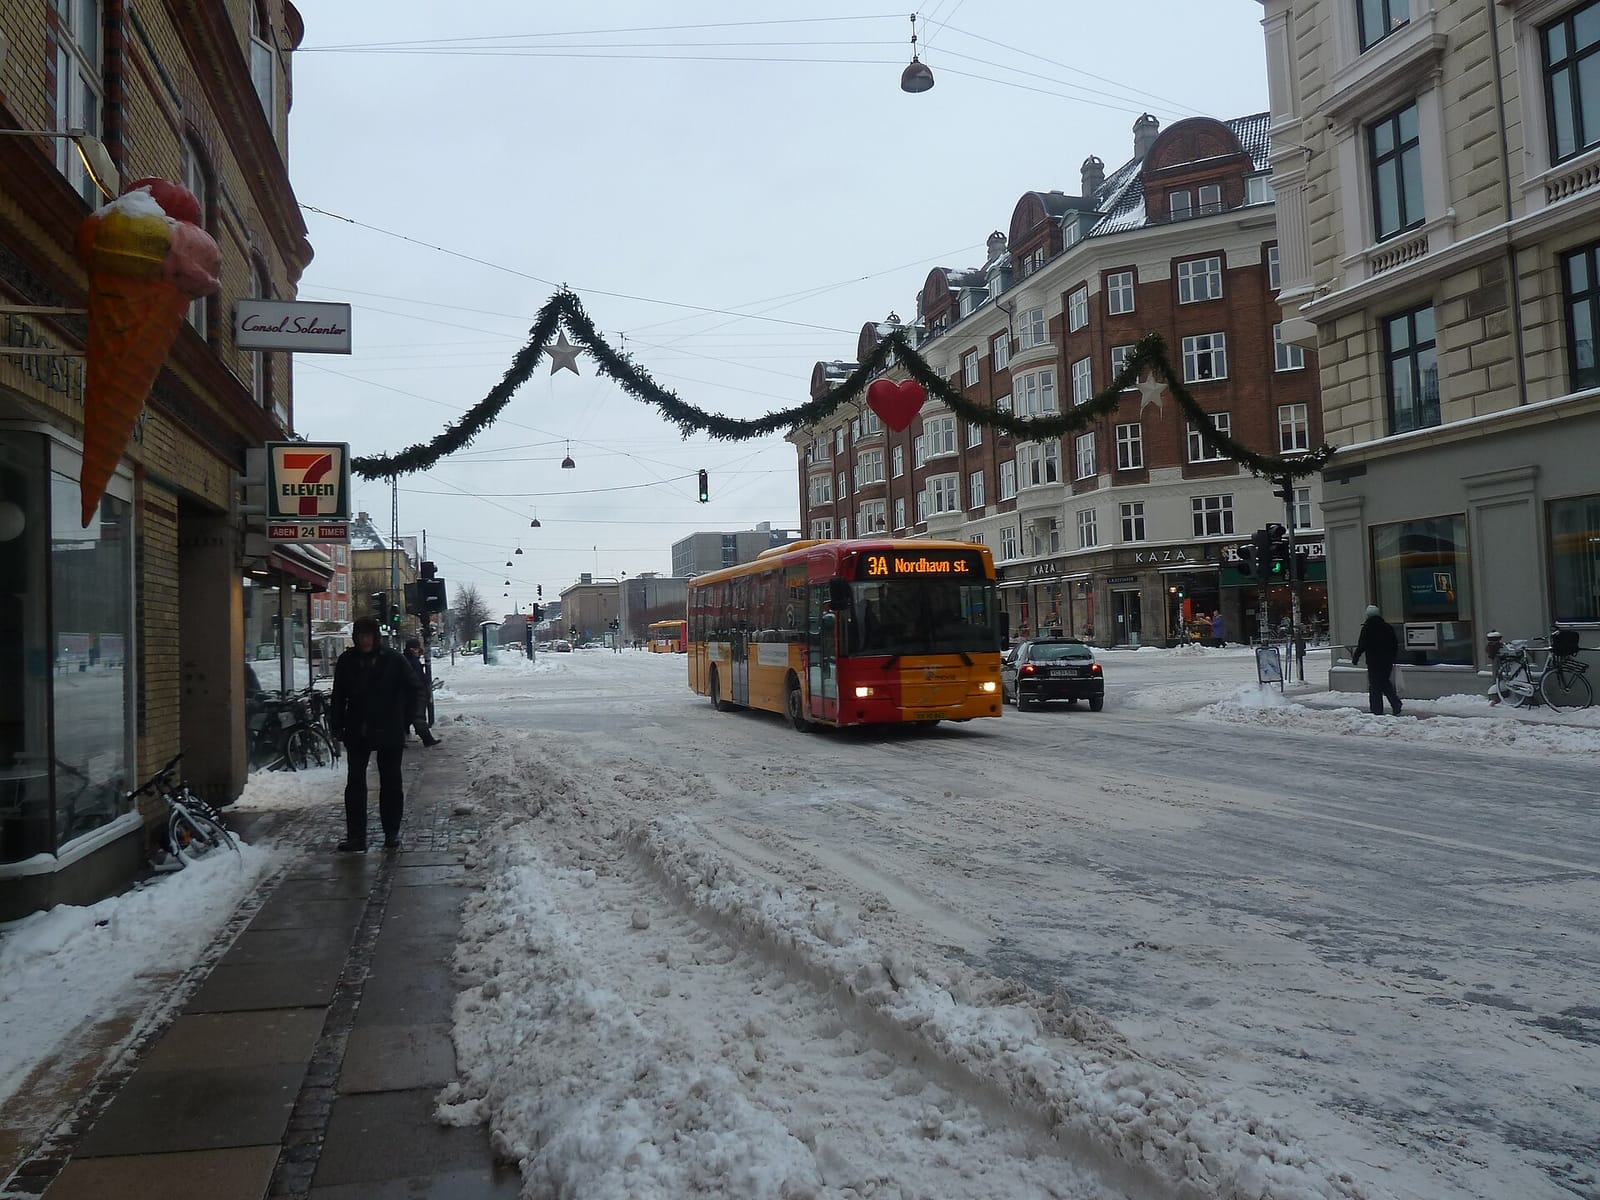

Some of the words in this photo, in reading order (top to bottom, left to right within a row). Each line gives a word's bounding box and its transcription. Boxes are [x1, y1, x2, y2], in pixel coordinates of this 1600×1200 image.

[242, 314, 289, 332] Consol
[286, 316, 346, 335] Solcenter
[284, 454, 332, 515] 7
[302, 527, 315, 537] 24
[320, 528, 345, 537] TIMER
[1135, 550, 1186, 564] KAZA
[868, 556, 888, 575] 3A
[895, 557, 950, 573] Nordhavn
[1033, 562, 1056, 574] KAZA
